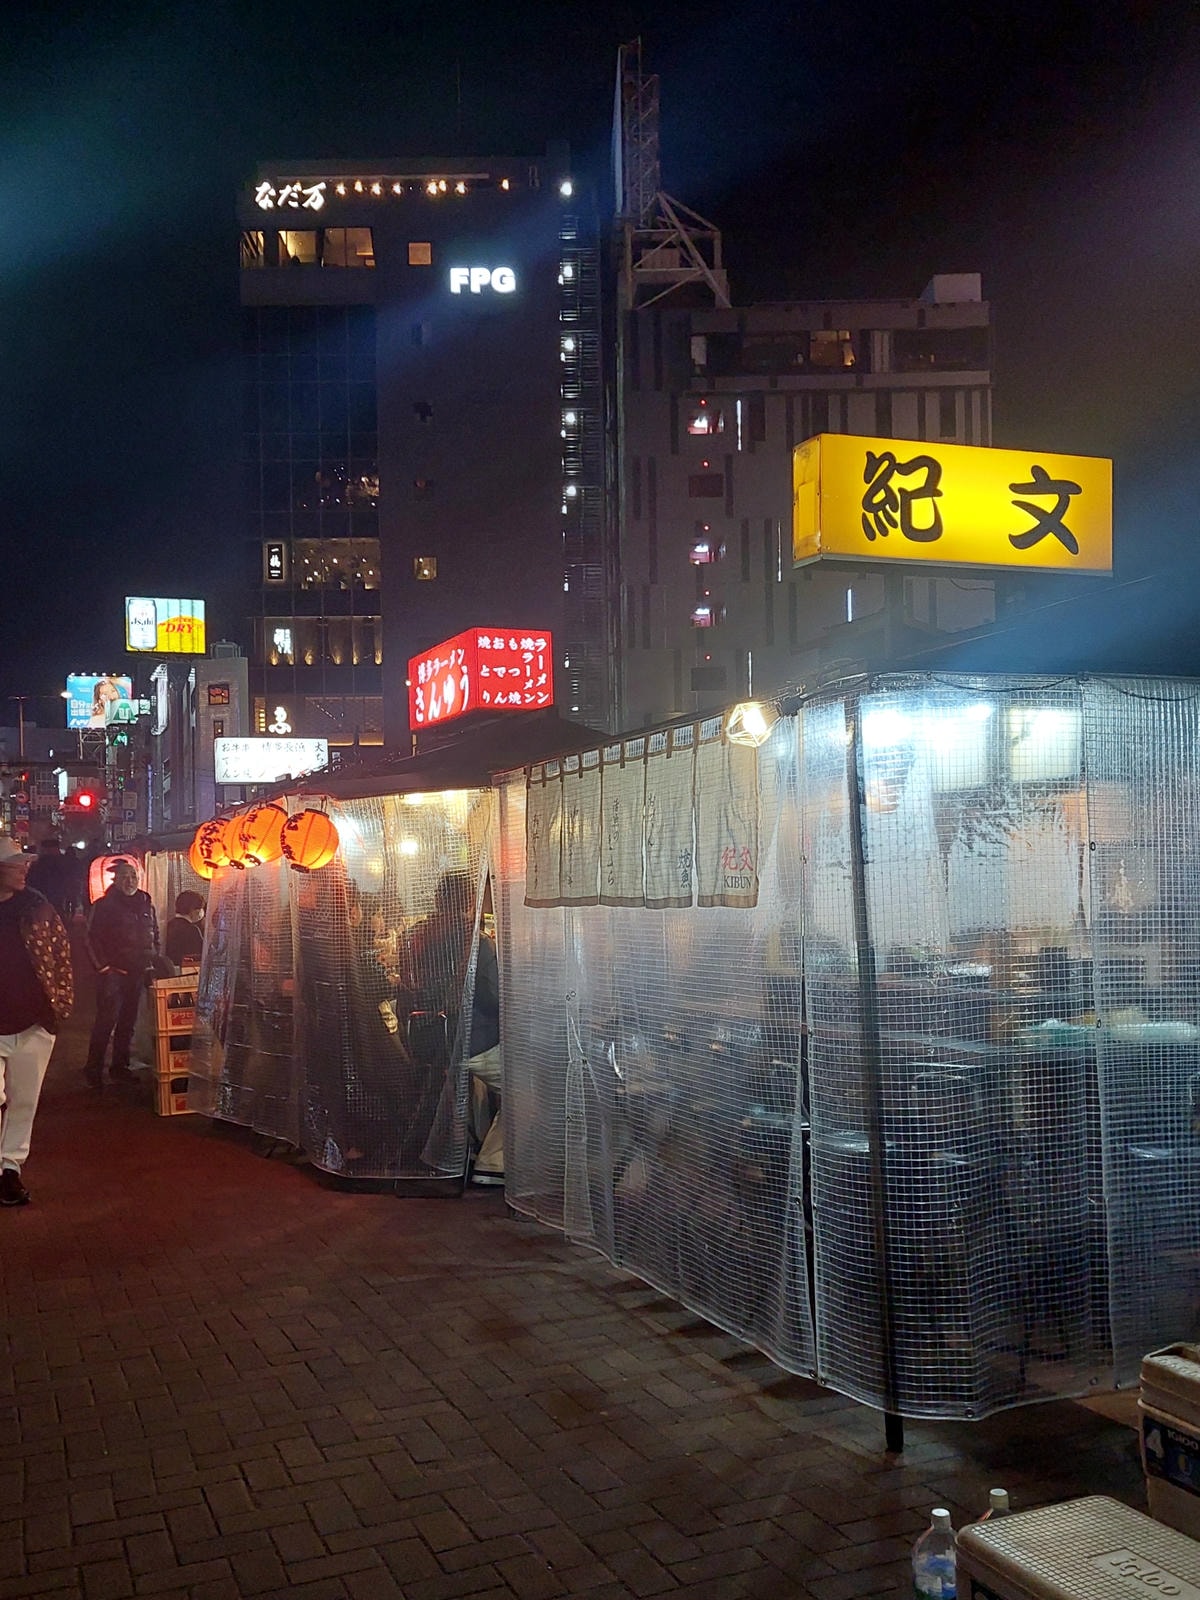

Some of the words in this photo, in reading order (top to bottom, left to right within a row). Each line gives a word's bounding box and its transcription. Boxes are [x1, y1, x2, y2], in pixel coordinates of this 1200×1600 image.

[254, 181, 327, 210] なだ万
[449, 266, 517, 294] FPG
[861, 450, 1083, 556] 紀文
[165, 623, 194, 634] DRY
[126, 810, 134, 820] P
[721, 846, 754, 872] 紀文
[723, 875, 752, 889] KIBUN
[1167, 1429, 1199, 1451] IGLOO
[1109, 1556, 1182, 1596] igloo
